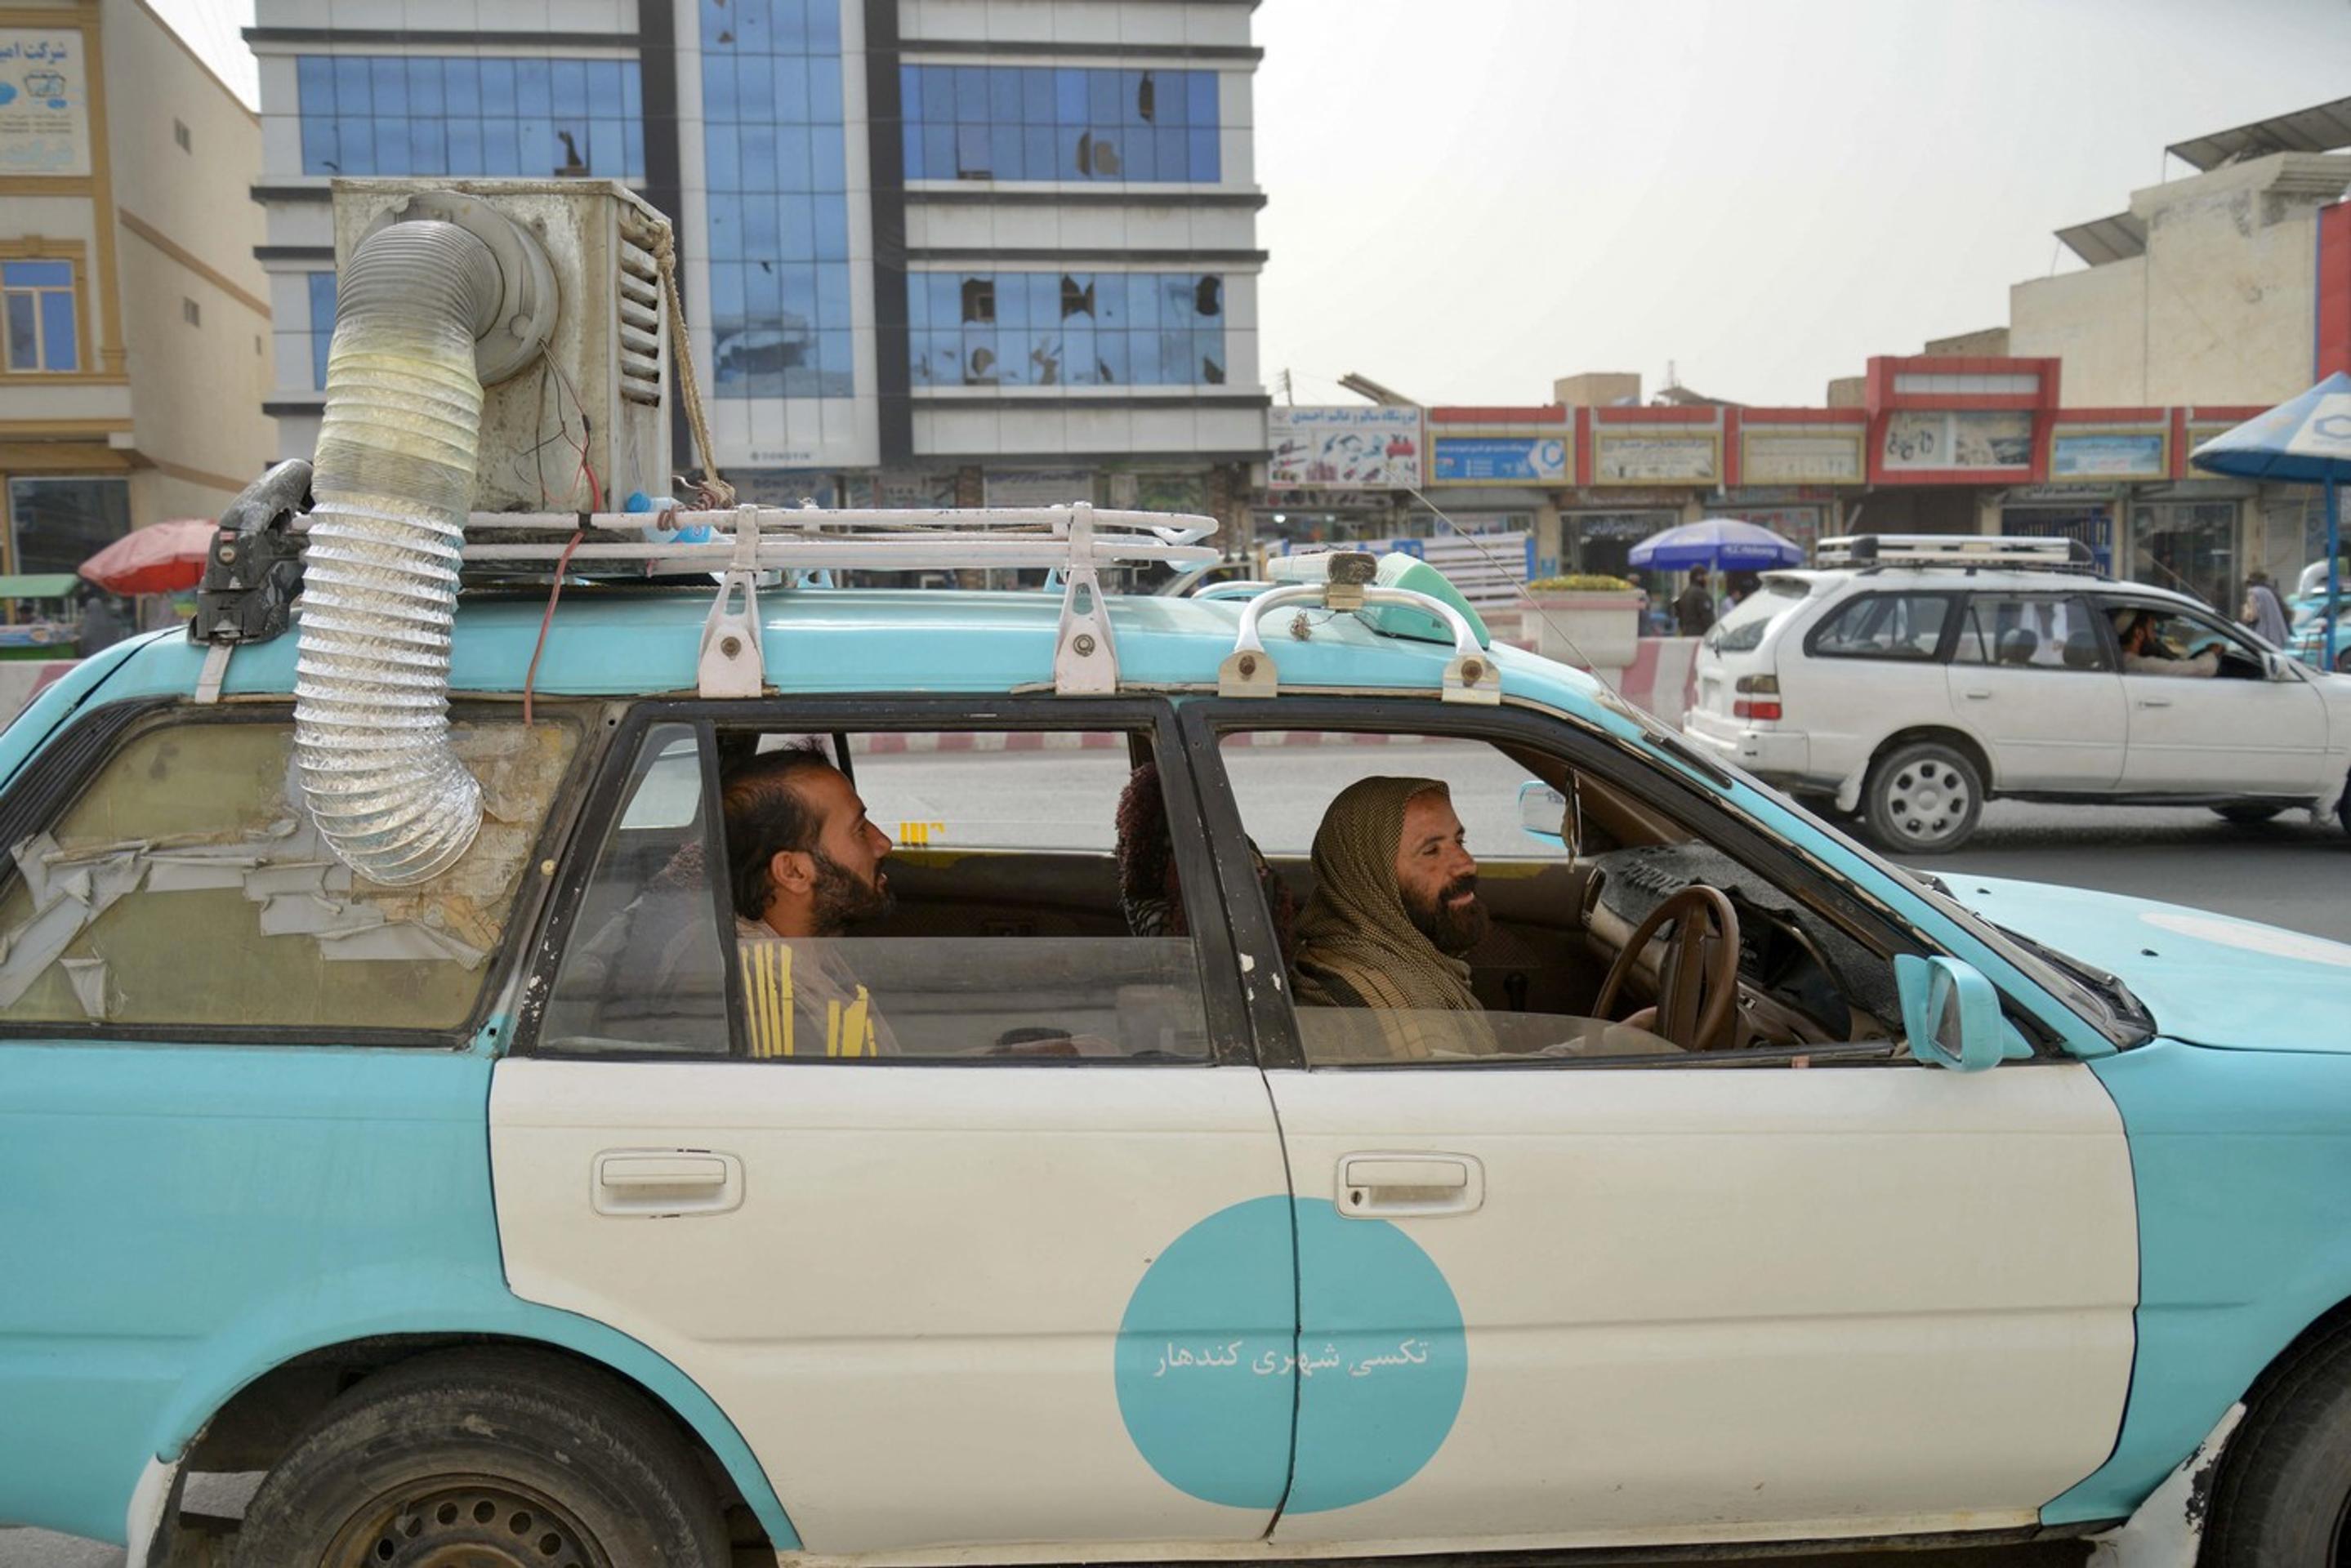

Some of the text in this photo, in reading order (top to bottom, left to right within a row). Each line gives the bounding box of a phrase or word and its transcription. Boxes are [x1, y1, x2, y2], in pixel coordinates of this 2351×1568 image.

[1154, 1339, 1429, 1377] تکسی شهری کندهار
